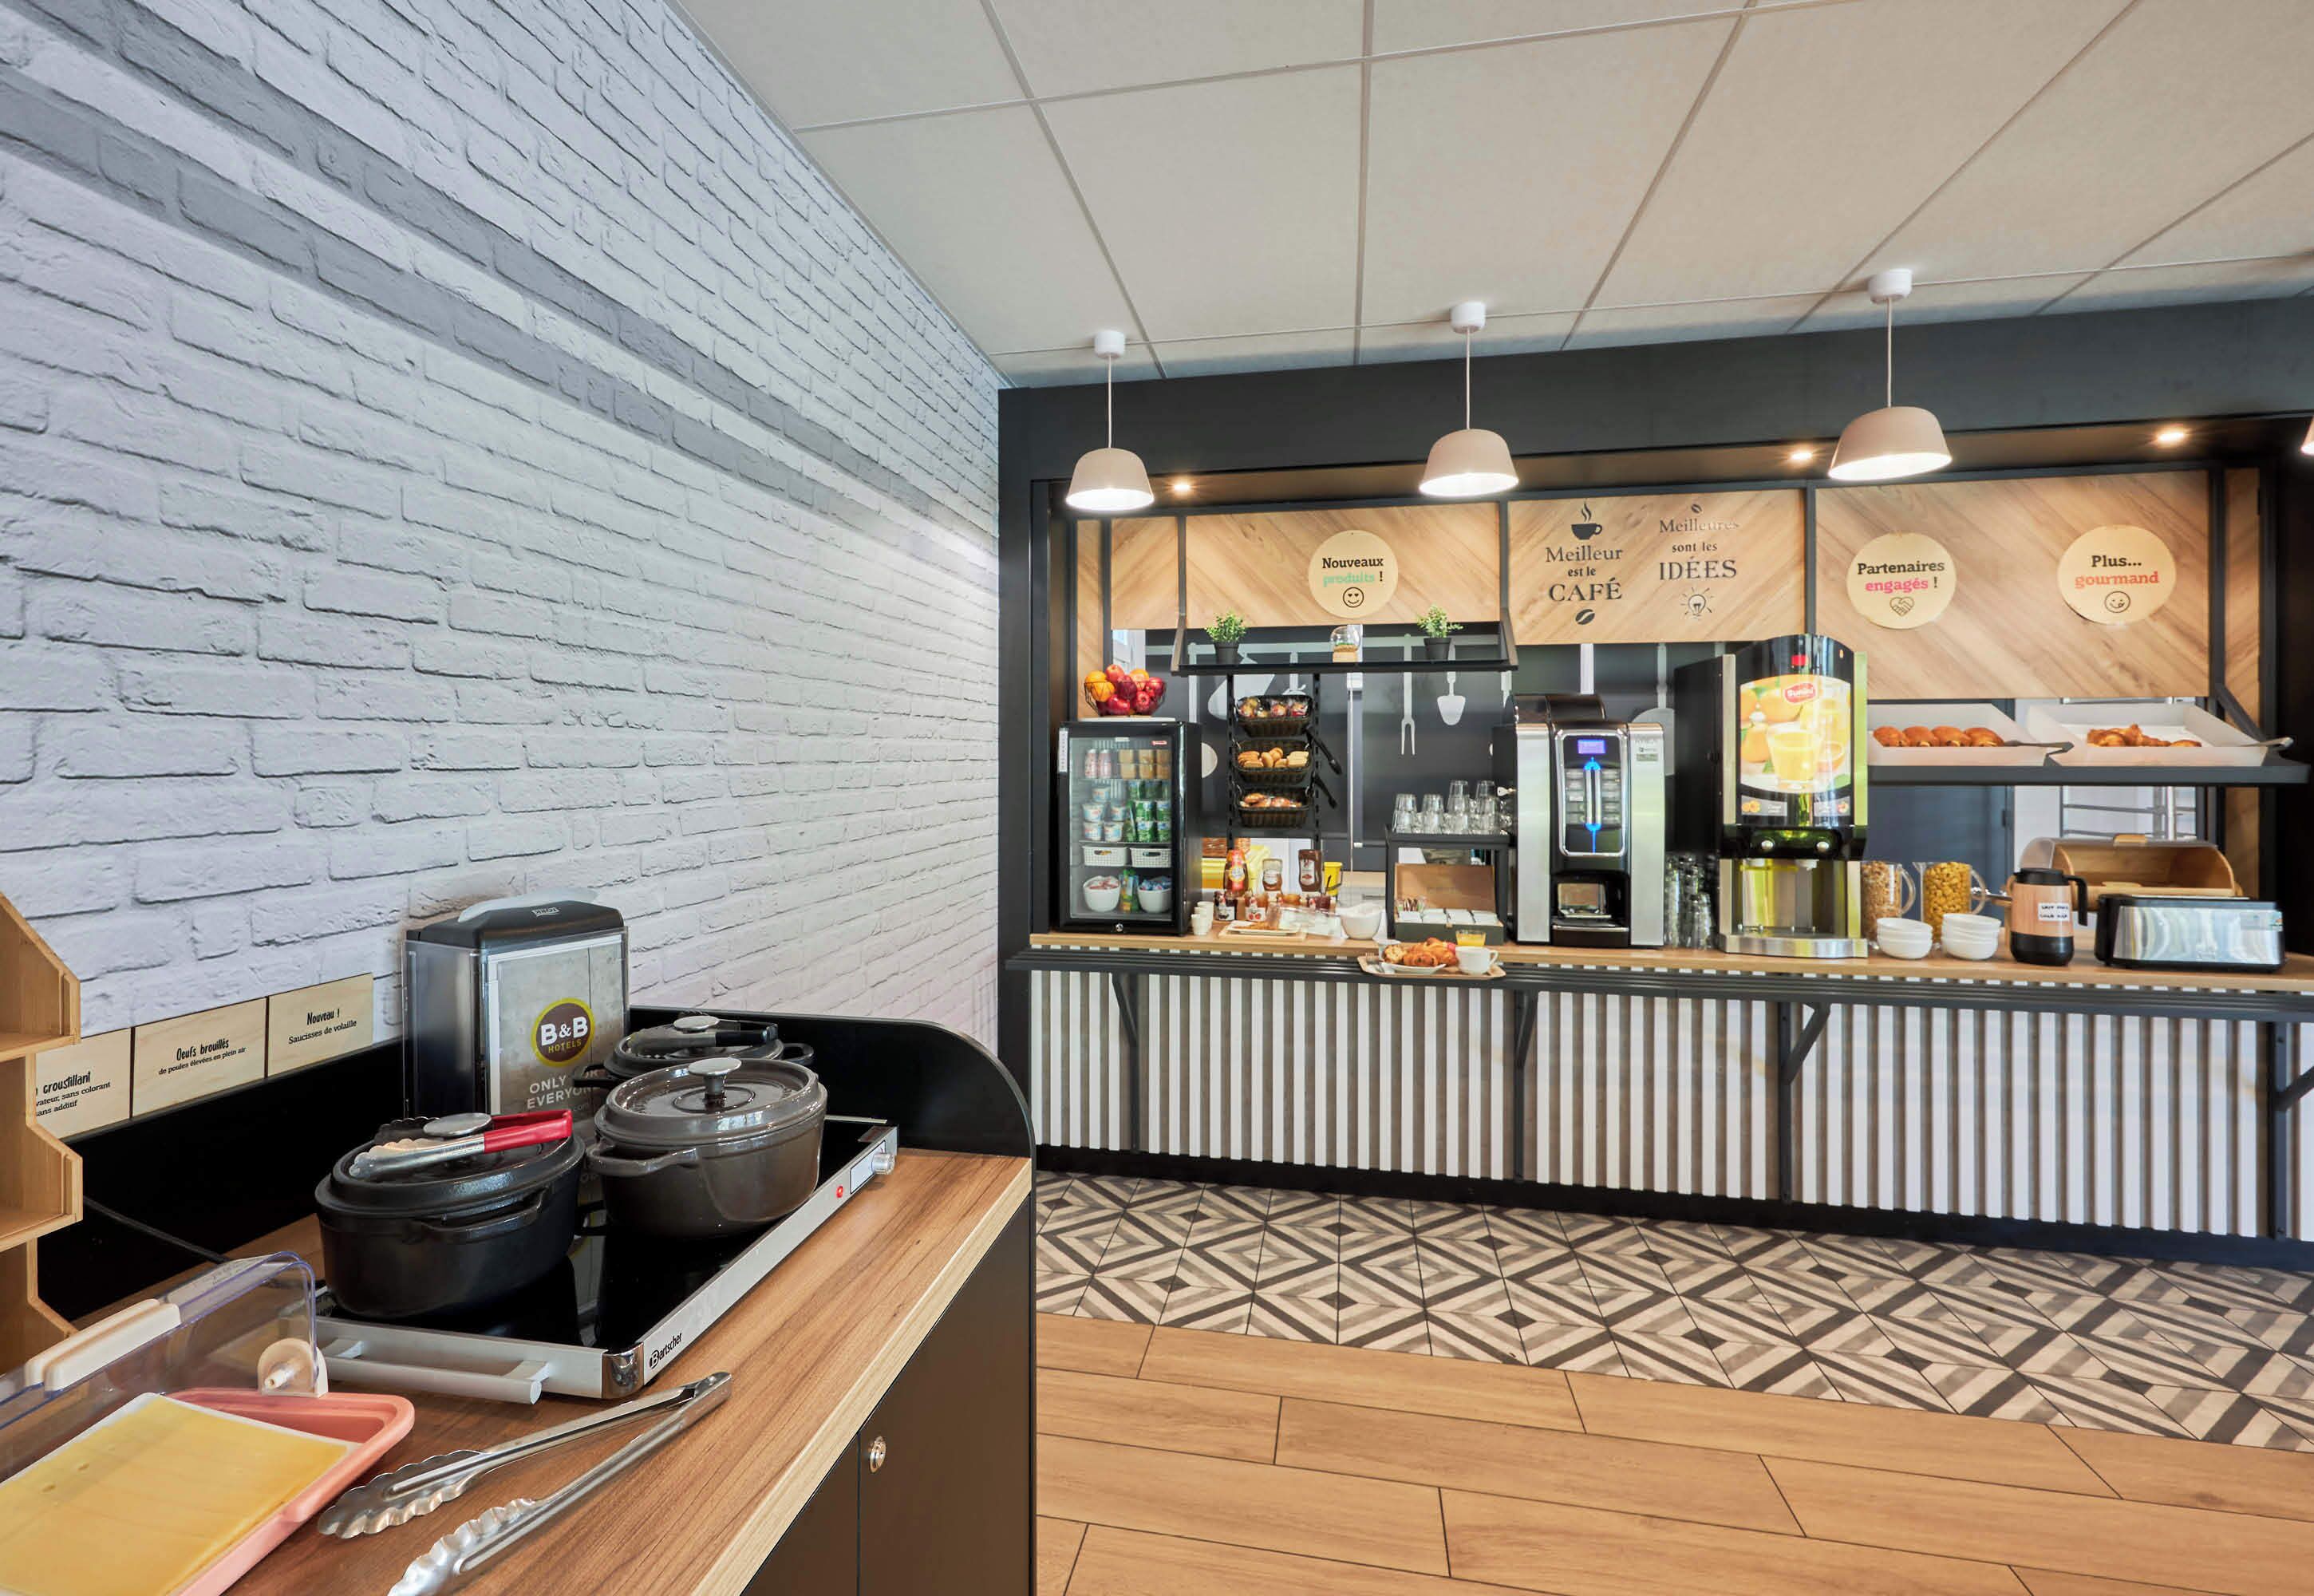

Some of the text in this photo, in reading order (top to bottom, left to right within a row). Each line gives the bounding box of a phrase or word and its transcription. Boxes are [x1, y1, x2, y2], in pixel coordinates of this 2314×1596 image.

[1659, 518, 1739, 533] Meilleures
[1546, 544, 1623, 563] Meilleur
[1672, 541, 1718, 553] sont les
[1322, 557, 1384, 569] Nouveaux
[1659, 556, 1737, 580] IDÉES
[1858, 560, 1945, 575] Partenaires
[2091, 555, 2142, 567] Plus...
[1323, 571, 1375, 587] produits
[1567, 566, 1597, 577] est le
[2075, 571, 2159, 589] gourmand
[1549, 577, 1622, 602] CAFÉ
[1865, 577, 1929, 594] engagés
[306, 1009, 334, 1025] Nouveau
[288, 1020, 357, 1045] Saucisses de volaille
[541, 1016, 588, 1046] B&B
[176, 1037, 230, 1061] Oeufs brouillés
[548, 1039, 582, 1053] HOTELS
[168, 1062, 189, 1074] poules
[190, 1056, 213, 1067] élevées
[222, 1050, 237, 1060] plein
[43, 1070, 91, 1094] croustillant
[61, 1090, 80, 1100] sans
[81, 1081, 111, 1095] colorant
[529, 1075, 567, 1094] ONLY
[53, 1099, 77, 1112] additif
[527, 1087, 600, 1110] EVERYON
[649, 1332, 682, 1369] Bartscher
